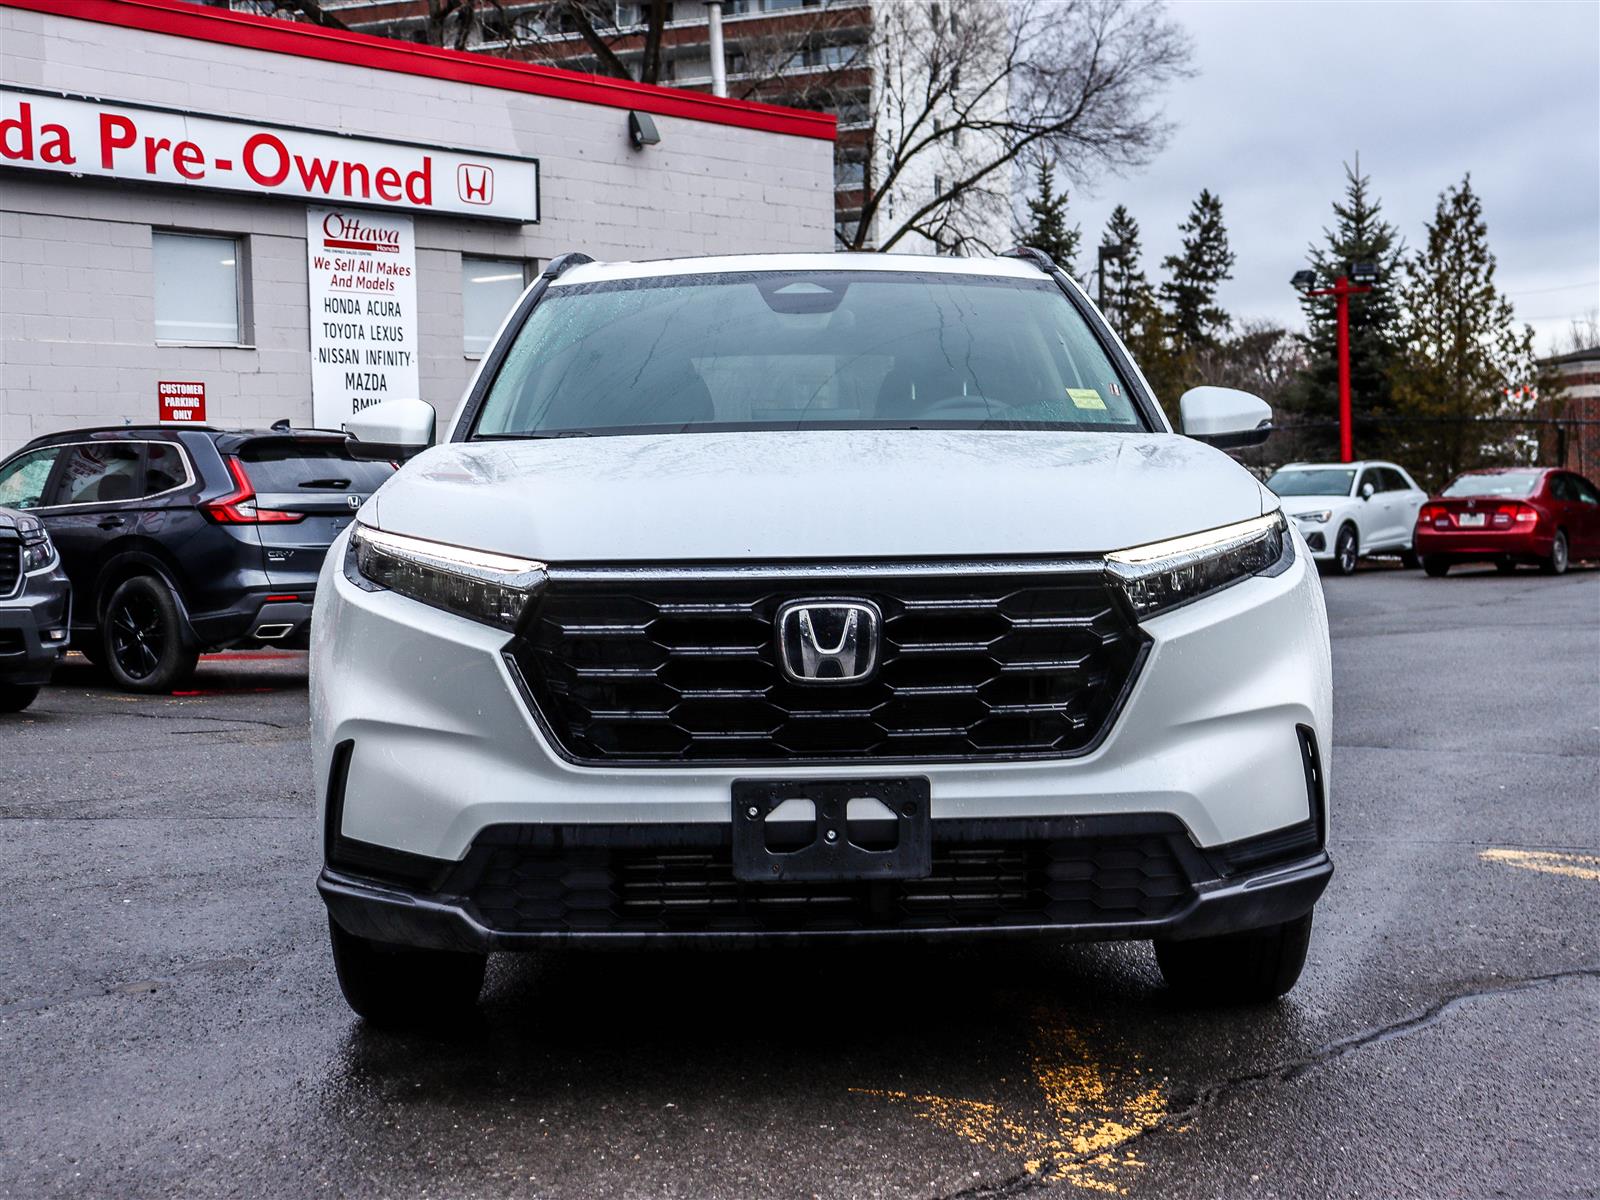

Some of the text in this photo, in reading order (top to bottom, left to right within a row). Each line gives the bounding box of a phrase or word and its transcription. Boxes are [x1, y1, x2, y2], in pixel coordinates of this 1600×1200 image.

[0, 102, 432, 206] da Pre-Owned
[323, 212, 400, 244] Ottawa
[314, 256, 411, 276] We Sell All Makes
[331, 274, 395, 291] And Models
[324, 297, 401, 317] HONDA ACURA
[323, 322, 403, 342] TOYOTA LEXUS
[319, 347, 411, 366] NISSAN INFINITY
[160, 383, 203, 395] CUSTOMER
[345, 372, 387, 391] MAZDA
[164, 396, 200, 407] PARKING
[172, 409, 193, 420] ONLY
